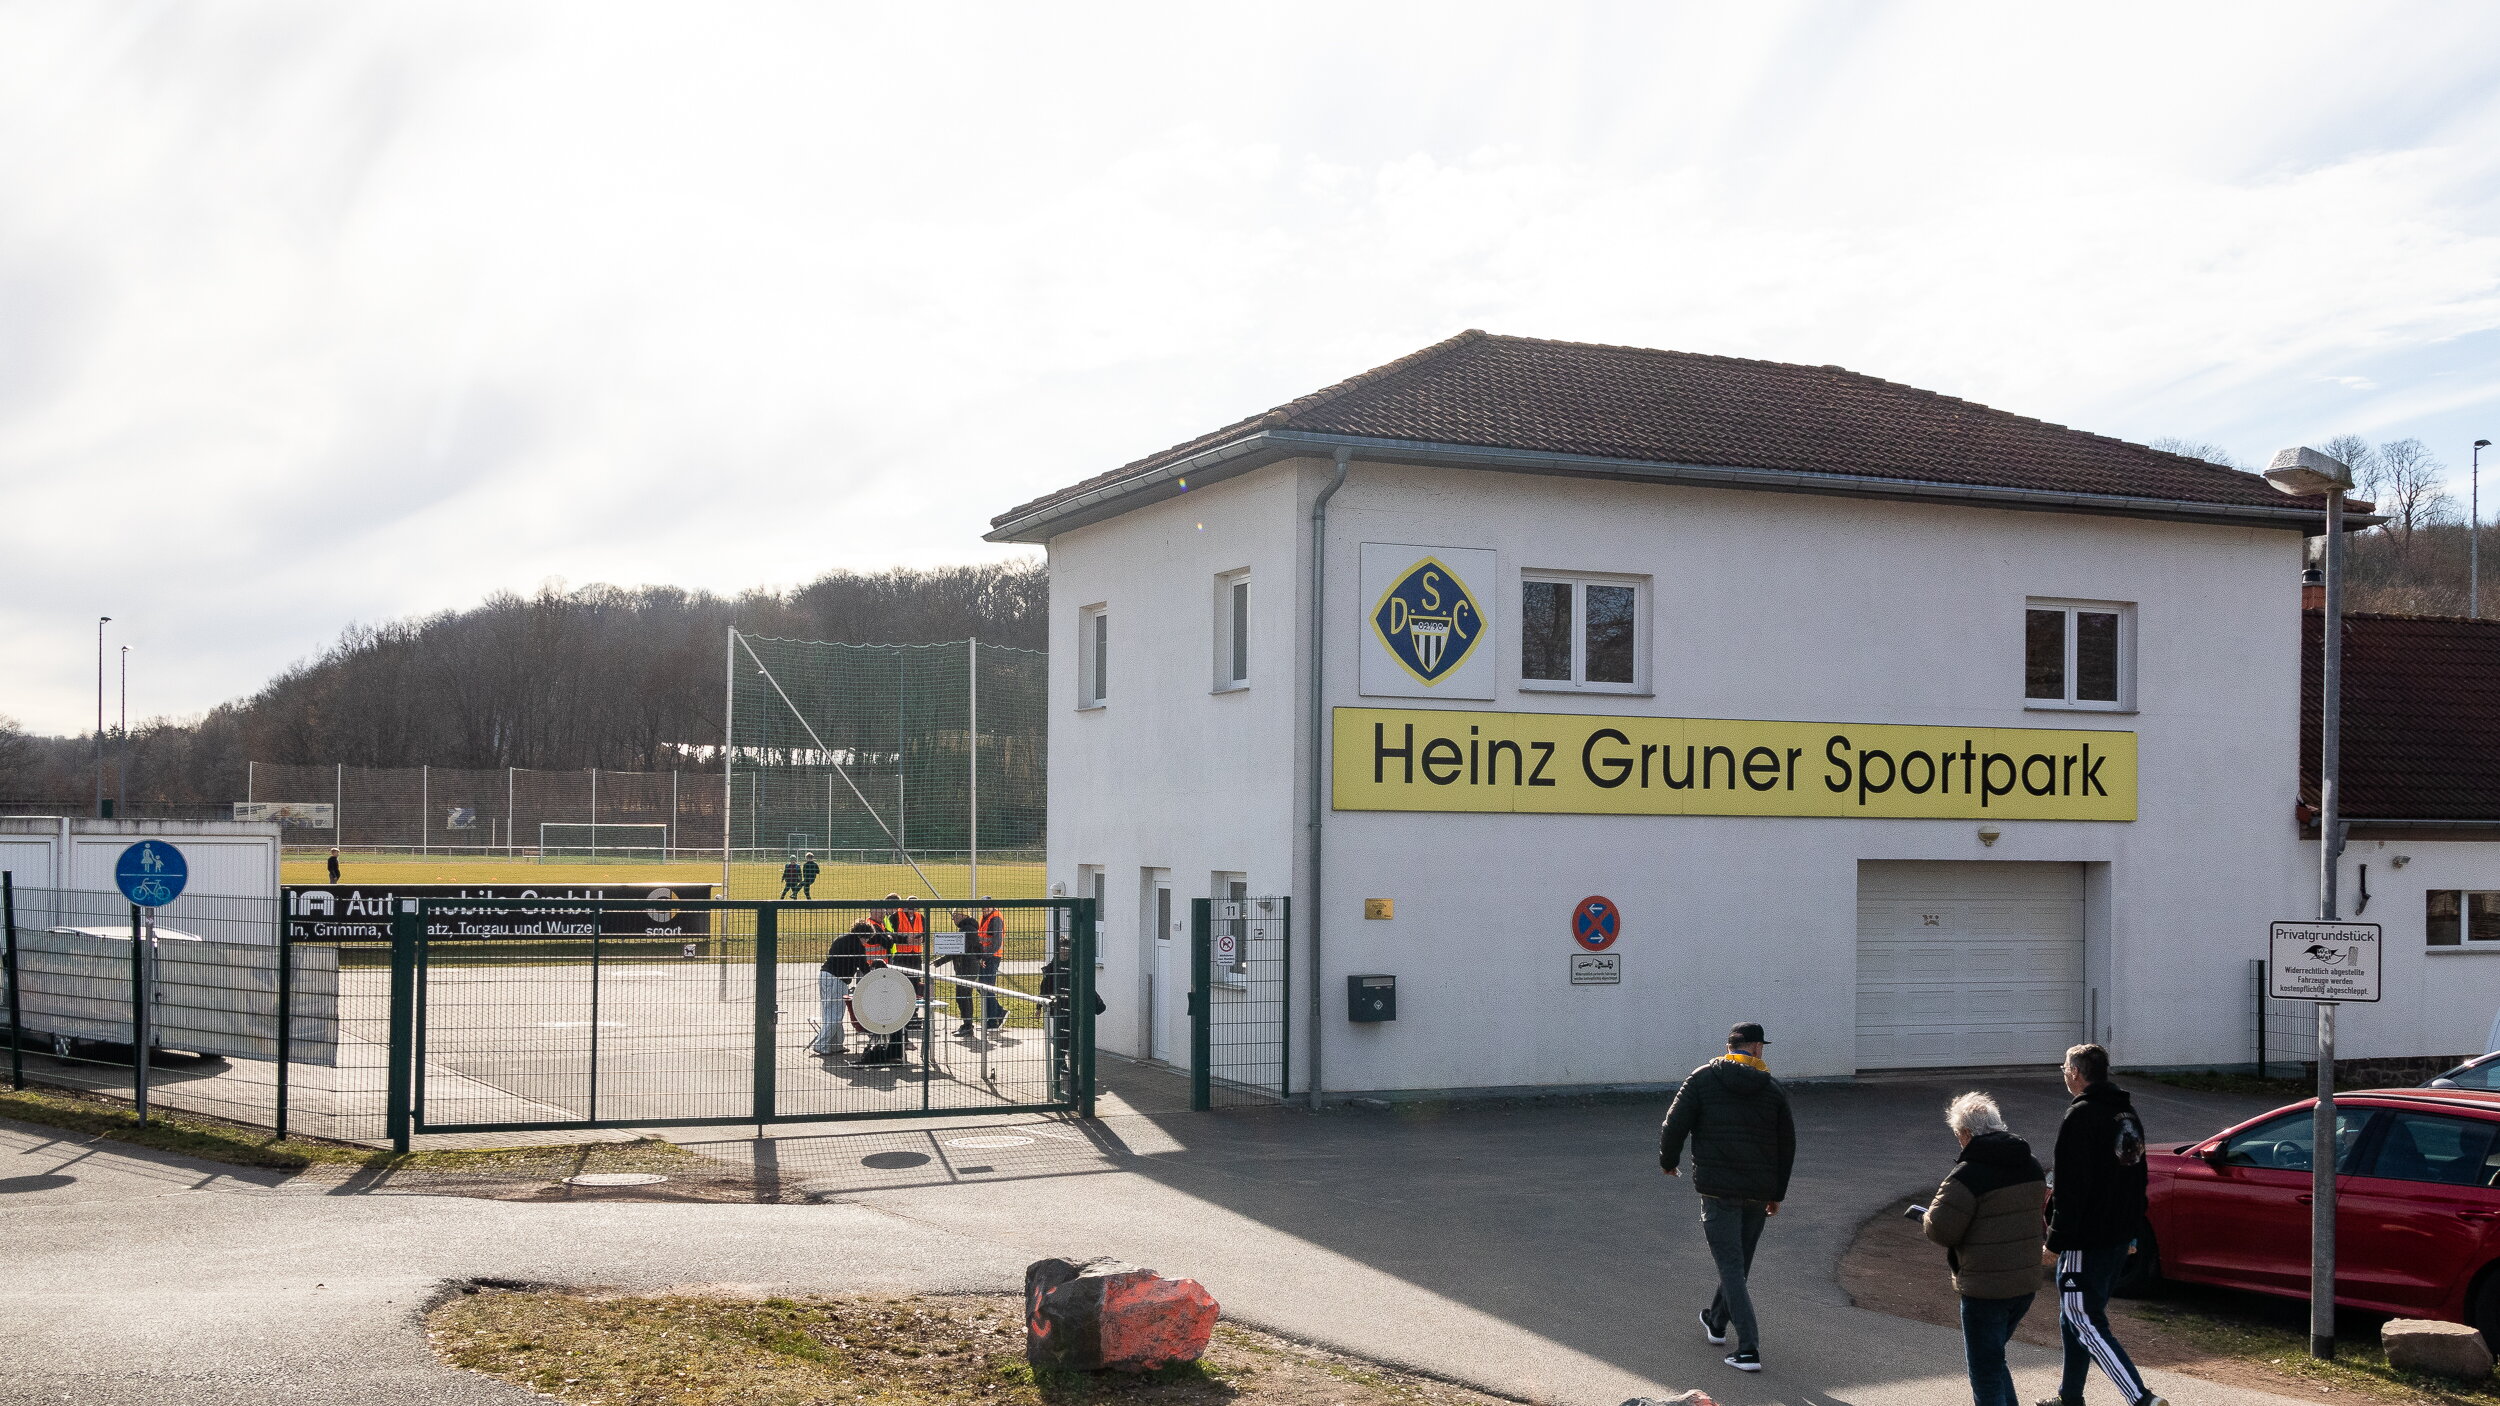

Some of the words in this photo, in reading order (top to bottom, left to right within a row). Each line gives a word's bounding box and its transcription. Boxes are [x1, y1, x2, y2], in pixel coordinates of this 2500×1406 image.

[1418, 622, 1444, 631] 02/90
[1373, 722, 1556, 787] Heinz
[1581, 728, 1802, 792] Gruner
[1823, 734, 2109, 808] Sportpark
[346, 890, 509, 916] Autmobile
[1225, 905, 1236, 916] 11
[314, 923, 381, 938] Grimma,
[457, 922, 509, 938] Torgau
[514, 921, 542, 935] und
[546, 920, 602, 935] Wurzen
[645, 926, 682, 937] smart
[2275, 928, 2375, 943] Privatgrundstück
[2284, 966, 2329, 975] Widerrechtlich
[2330, 968, 2364, 977] abgestellte
[2297, 976, 2329, 986] Fahrzeuge
[2330, 977, 2354, 985] werden
[2280, 985, 2325, 994] kostenpflichtig
[2326, 986, 2369, 996] abgeschleppt.
